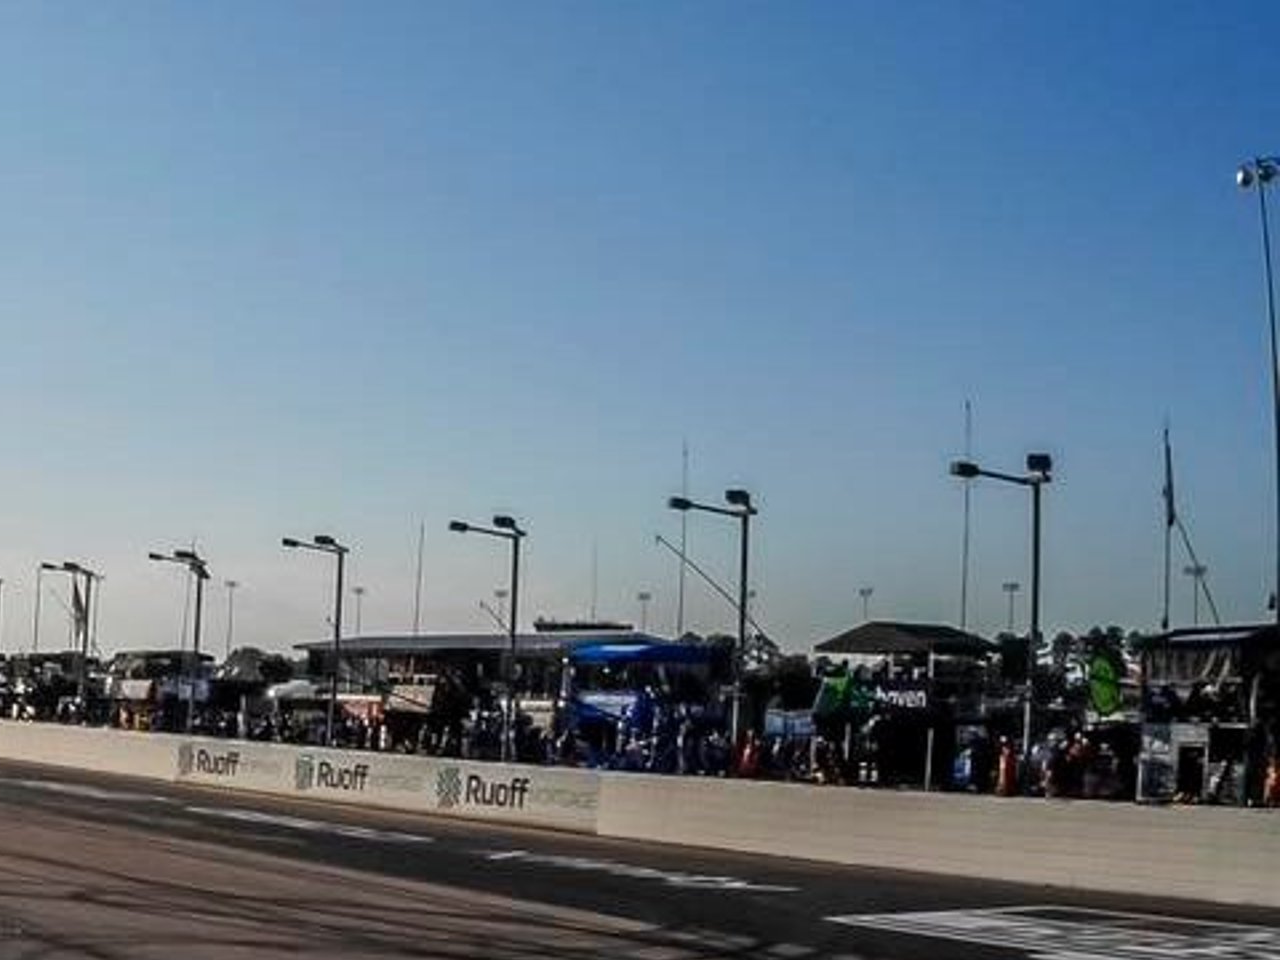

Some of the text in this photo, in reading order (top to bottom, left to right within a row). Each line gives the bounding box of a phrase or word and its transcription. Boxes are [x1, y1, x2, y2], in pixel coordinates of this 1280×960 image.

[197, 749, 240, 776] Ruoff
[318, 762, 370, 790] Ruoff
[466, 774, 530, 809] Ruoff
